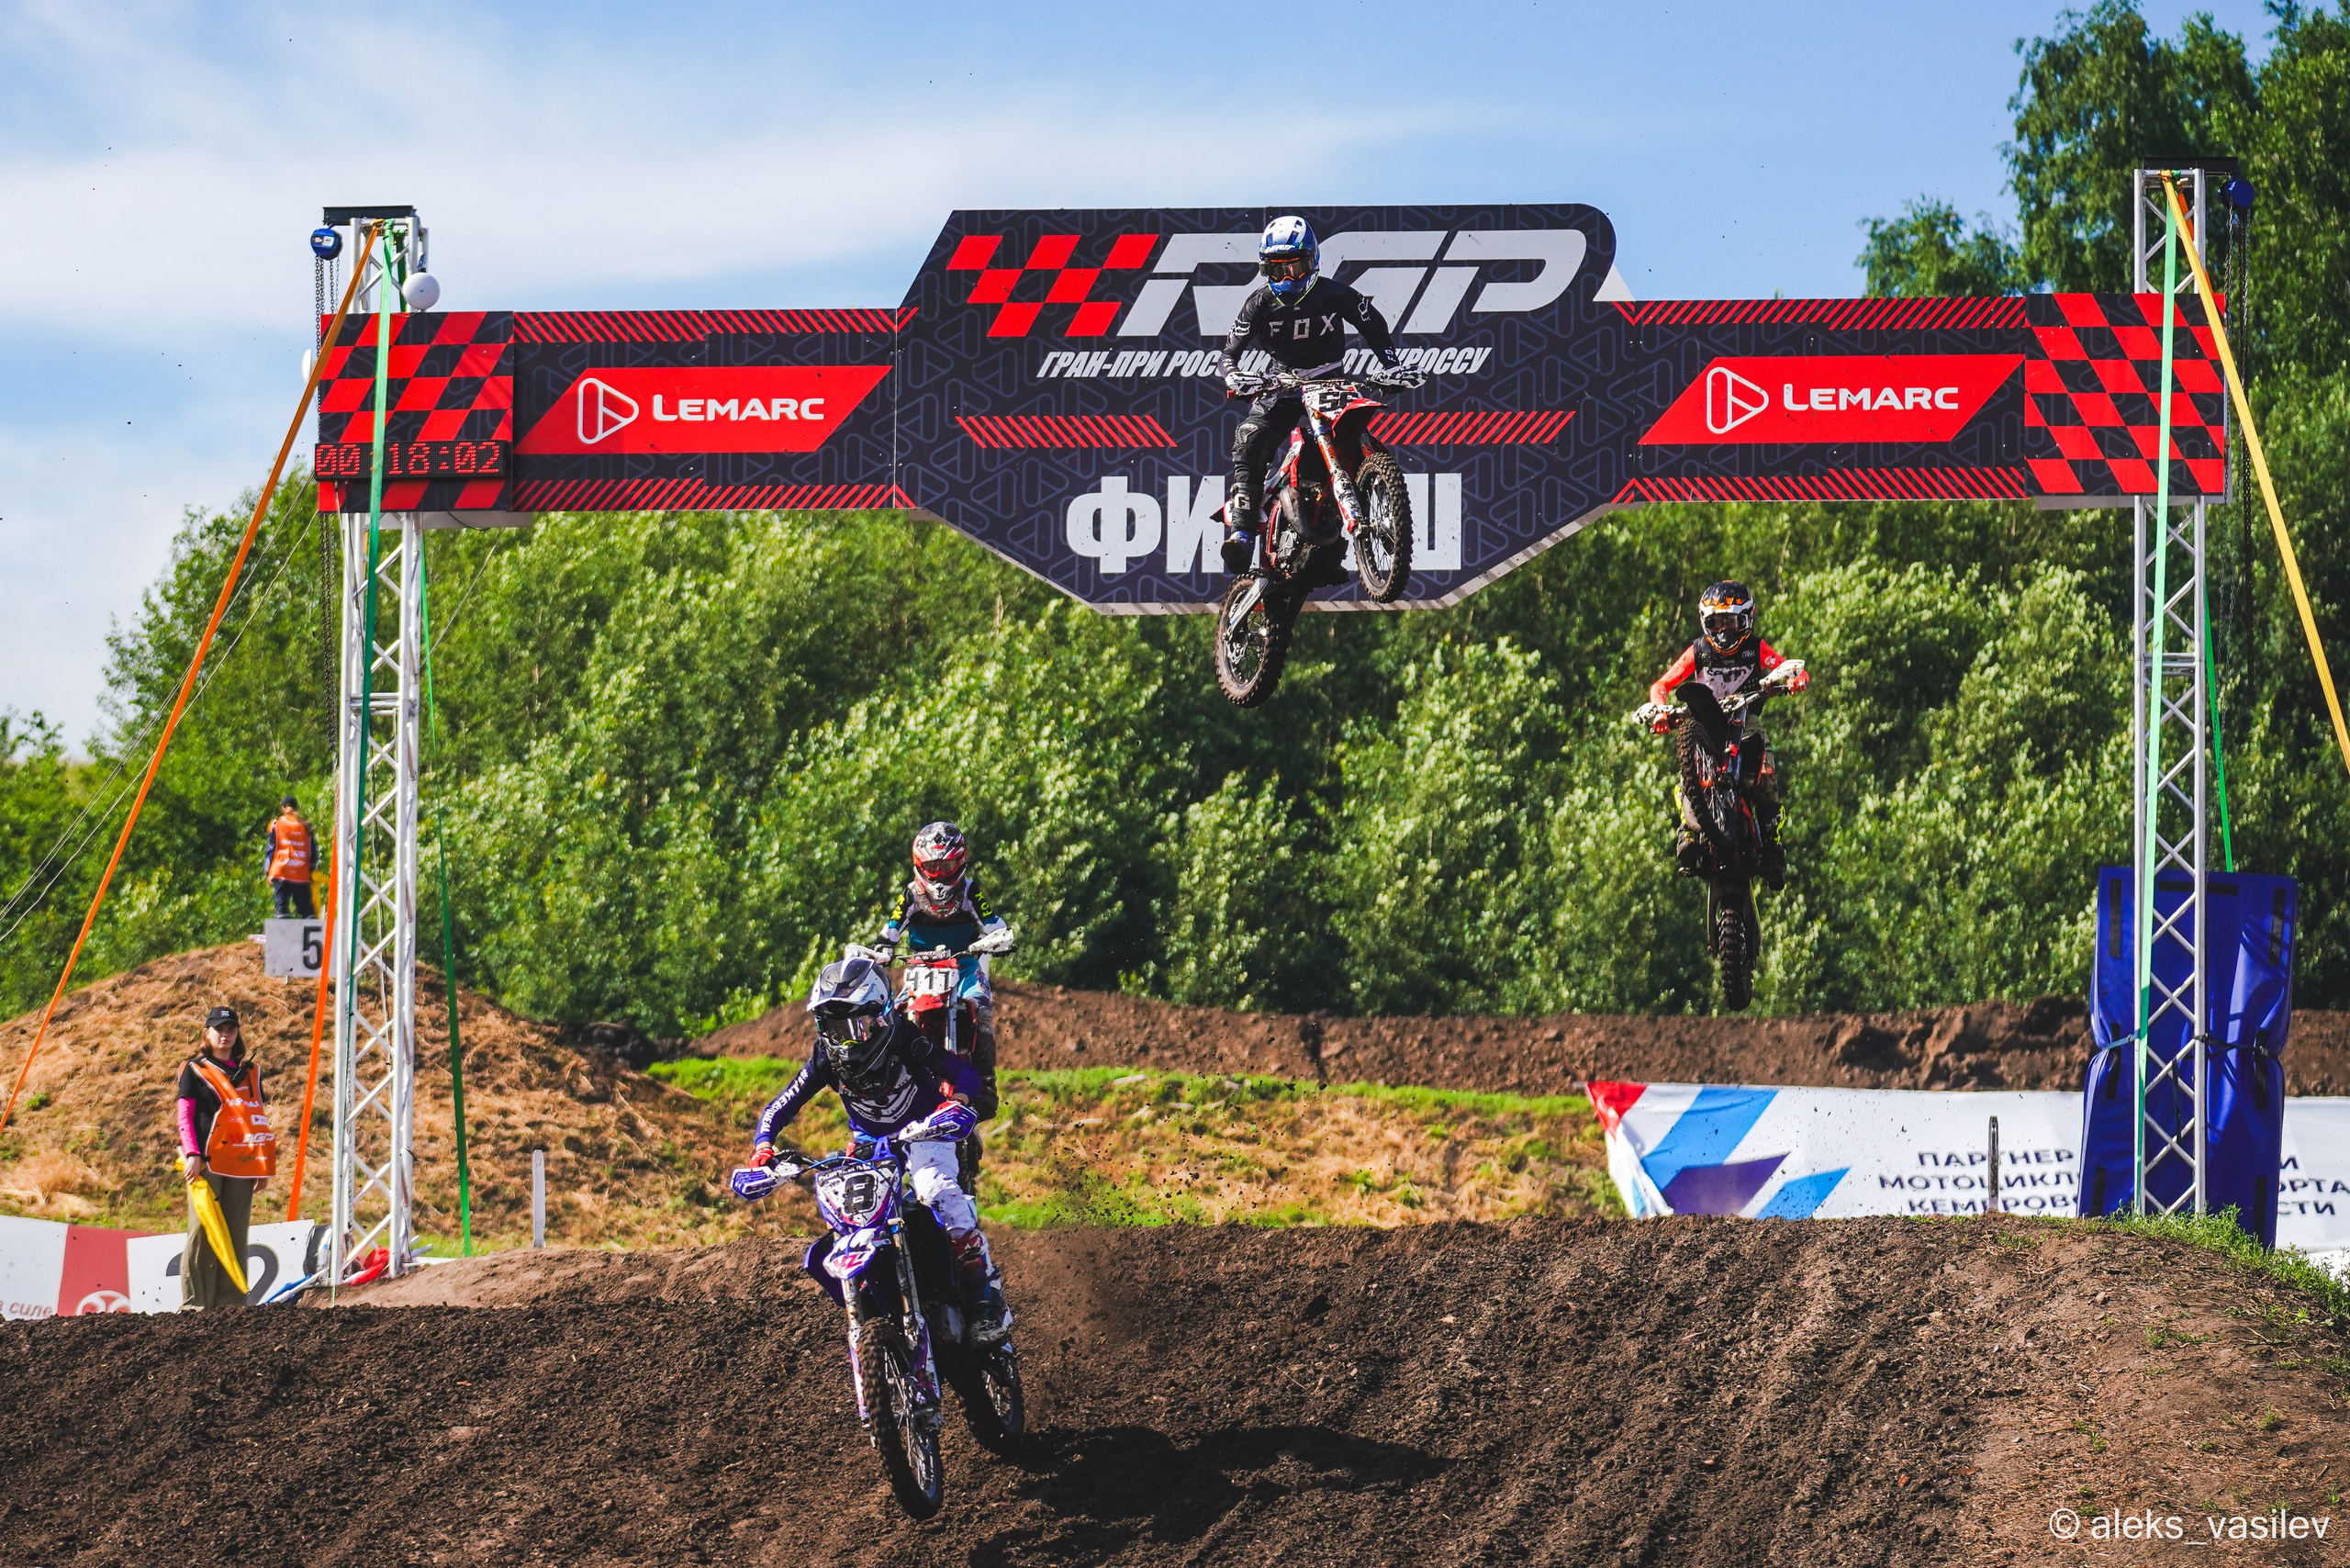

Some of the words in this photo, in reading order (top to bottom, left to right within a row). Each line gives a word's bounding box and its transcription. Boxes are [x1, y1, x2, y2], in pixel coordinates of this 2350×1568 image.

[1269, 313, 1337, 341] FOX
[1036, 350, 1170, 378] ГРАН-ПРИ
[652, 394, 824, 421] LEMARC
[1783, 383, 1959, 411] LEMARC
[1066, 473, 1462, 573] ФИШ
[302, 925, 323, 970] 5
[1918, 1148, 2075, 1167] ПАРНЕР
[844, 1173, 878, 1215] 8
[1878, 1171, 2079, 1191] МОТОИКЛ
[1908, 1194, 2078, 1213] КЕМРОВ
[9, 1302, 53, 1317] силе
